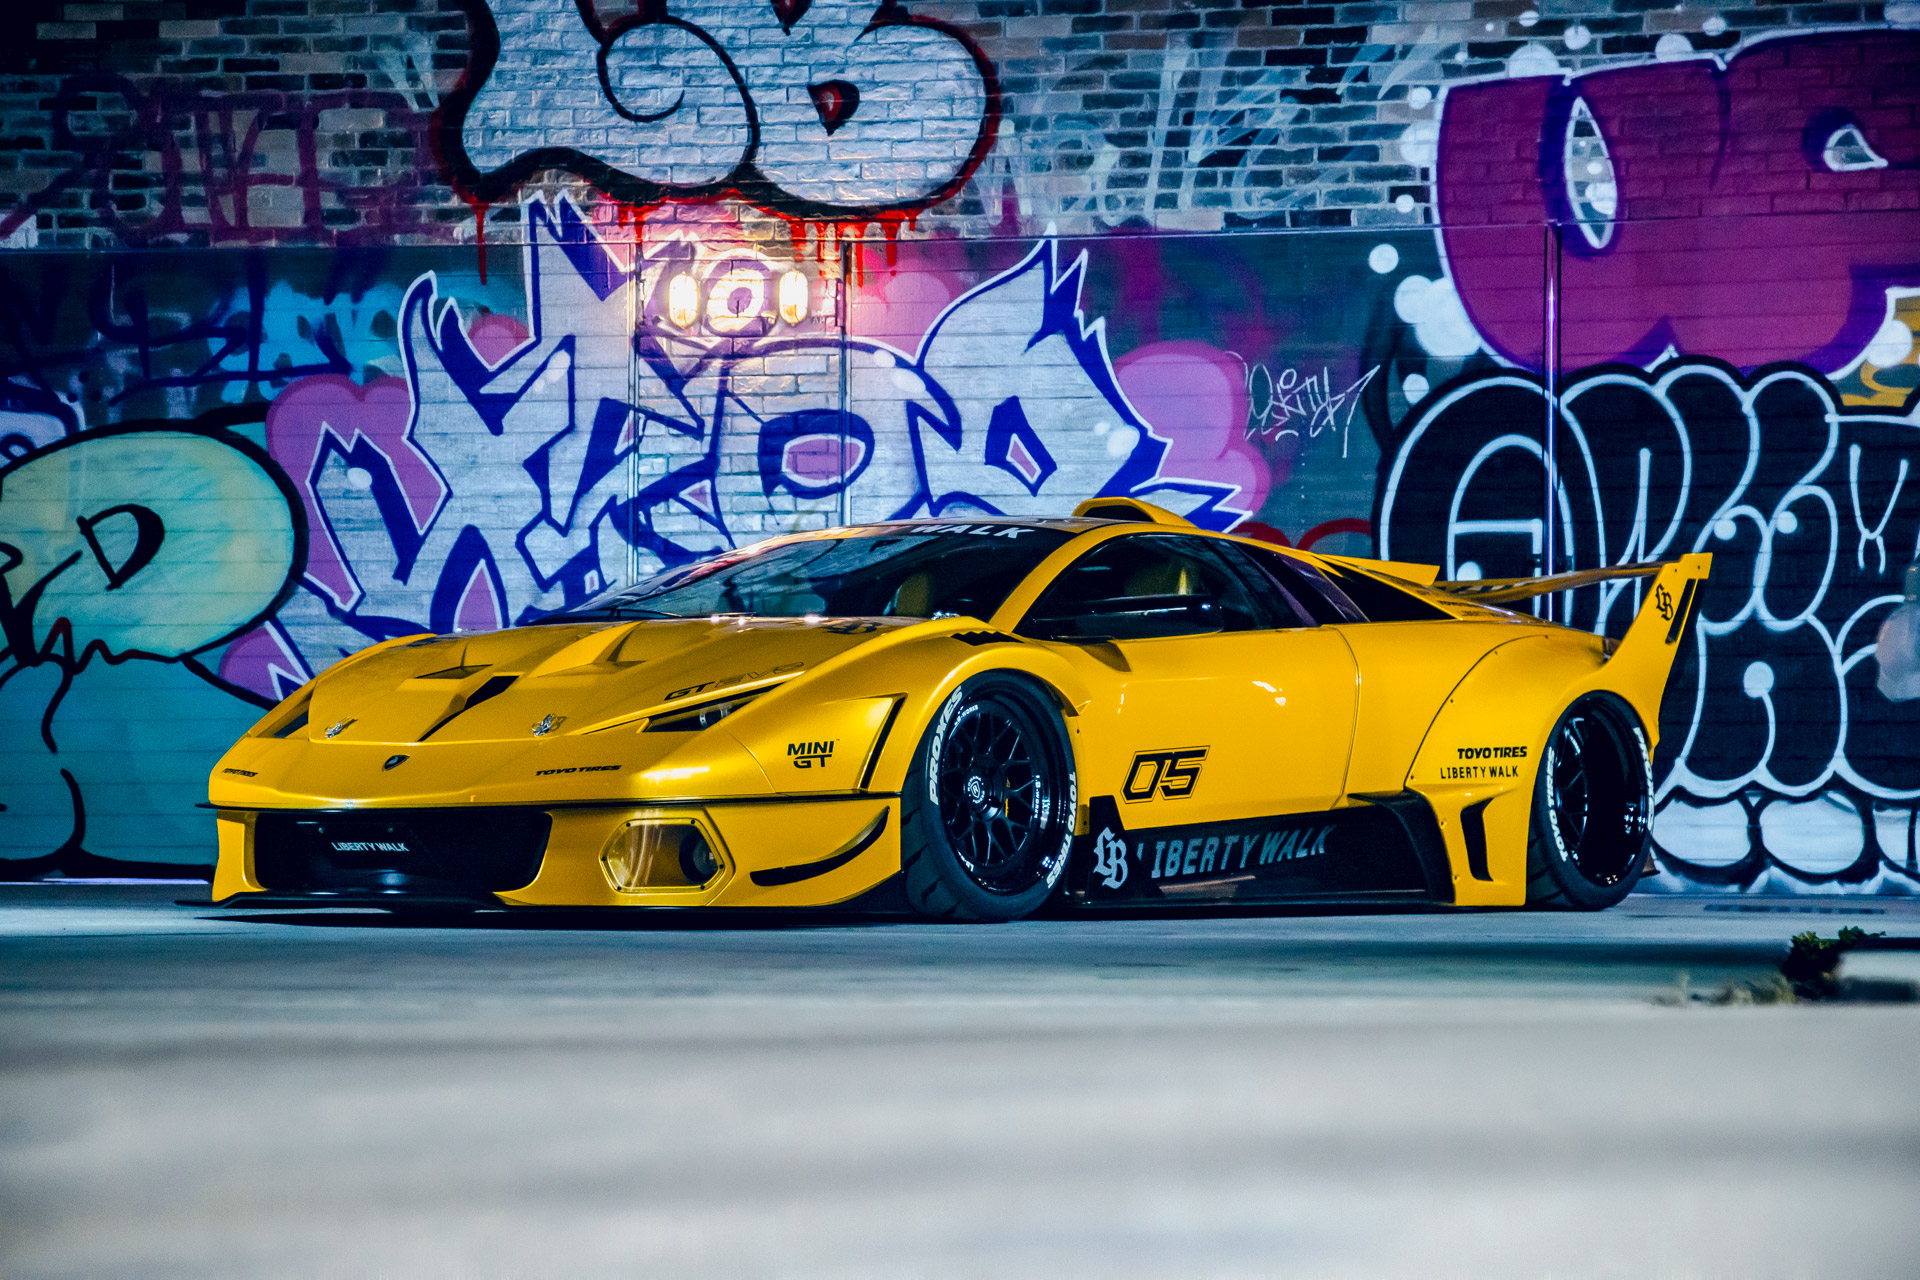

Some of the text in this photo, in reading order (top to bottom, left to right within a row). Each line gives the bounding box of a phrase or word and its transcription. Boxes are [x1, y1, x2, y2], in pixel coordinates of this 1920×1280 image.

[911, 525, 1035, 539] WALK
[787, 741, 835, 756] MINI
[929, 685, 962, 805] PROXES
[1457, 746, 1528, 760] TOYO TIRES
[793, 754, 833, 769] GT
[1120, 745, 1210, 804] 05
[1440, 765, 1519, 779] LIBERTY WALK
[1046, 771, 1078, 889] TOYO TIRES
[1549, 809, 1568, 862] TOYO
[331, 842, 409, 852] LIBERTY WALK
[1259, 824, 1337, 865] WALK
